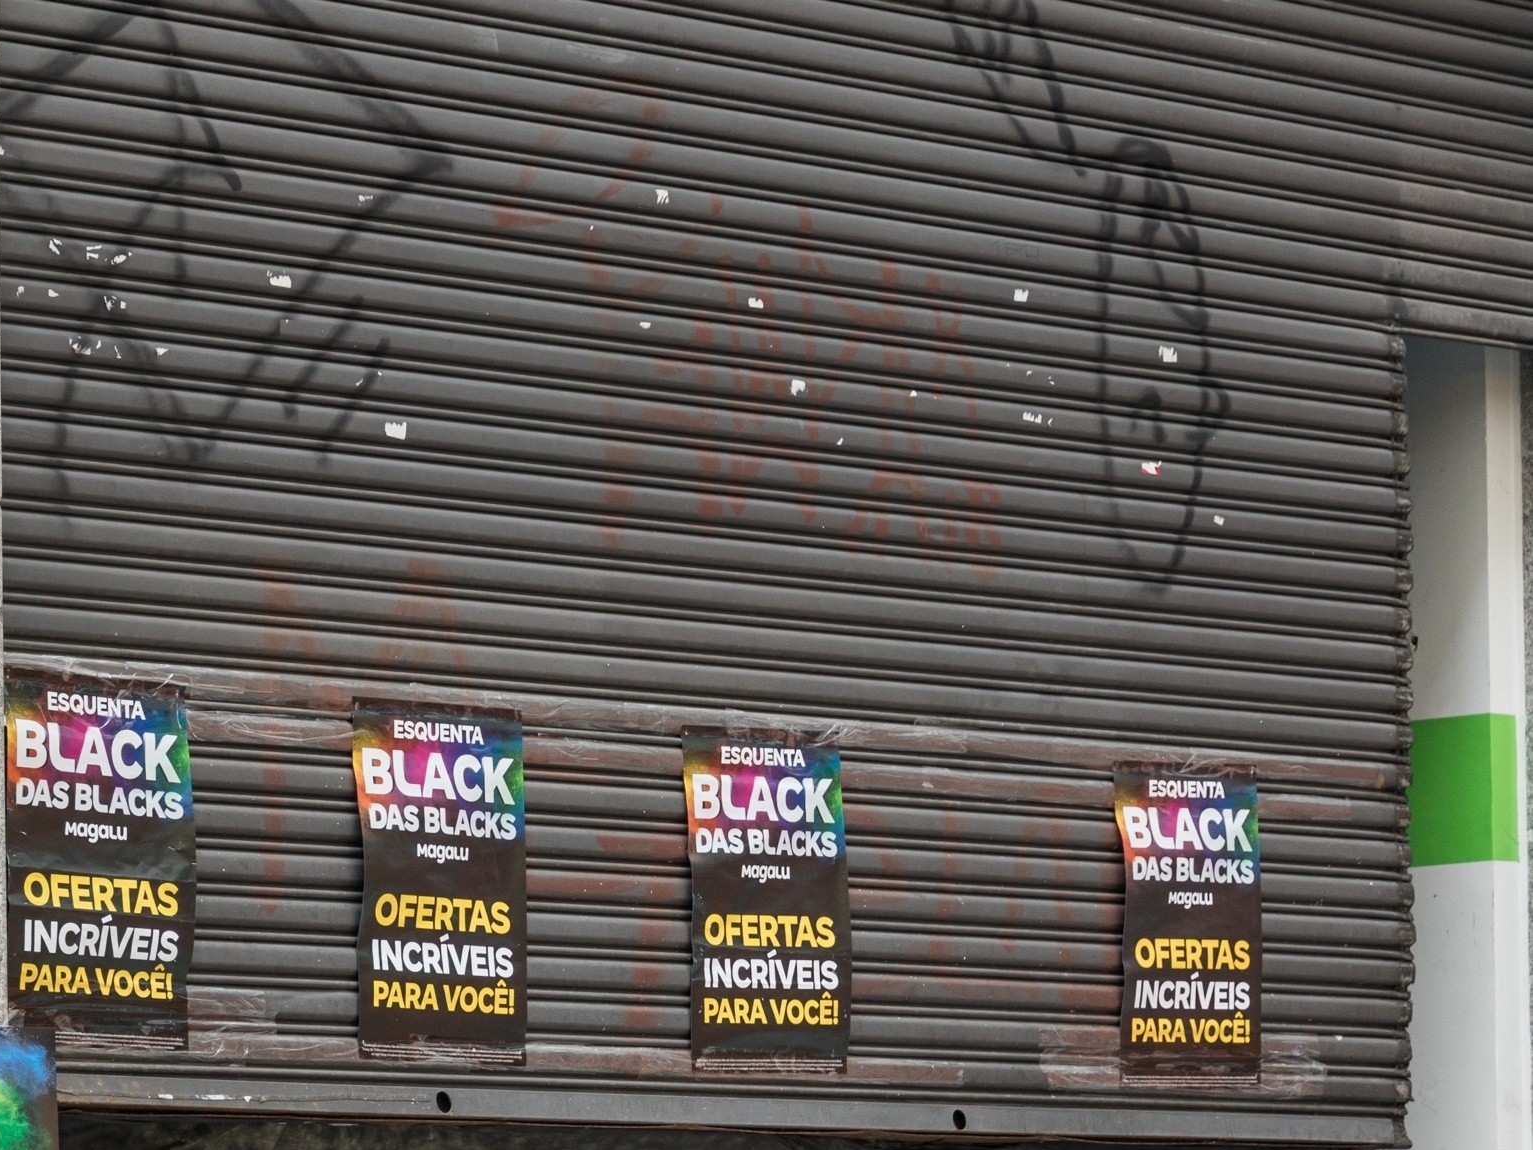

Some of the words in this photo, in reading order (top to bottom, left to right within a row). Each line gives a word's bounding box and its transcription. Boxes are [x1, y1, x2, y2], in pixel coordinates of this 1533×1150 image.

[47, 691, 146, 720] ESQUENTA
[393, 720, 484, 745] ESQUENTA
[15, 720, 179, 784] BLACK
[720, 746, 805, 767] ESQUENTA
[362, 748, 515, 805] BLACK
[1149, 780, 1225, 799] ESQUENTA
[16, 782, 69, 809] DAS
[75, 785, 184, 820] BLACKS
[693, 774, 834, 823] BLACK
[368, 808, 419, 832] DAS
[424, 809, 517, 841] BLACKS
[1123, 806, 1251, 853] BLACK
[696, 829, 744, 854] DAS
[748, 831, 837, 858] BLACKS
[1133, 856, 1173, 881] DAS
[1177, 858, 1254, 884] BLACKS
[23, 874, 178, 917] OFERTAS
[375, 894, 510, 935] OFERTAS
[704, 915, 835, 948] OFERTAS
[23, 917, 178, 962] INCRÍVEIS
[372, 935, 513, 978] INCRÍVEIS
[1134, 939, 1250, 970] OFERTAS
[19, 964, 90, 994] PARA
[95, 966, 173, 1000] VOCÊ!
[703, 951, 839, 990] INCRÍVEIS
[373, 980, 441, 1010] PARA
[446, 981, 515, 1016] VOCÊ!
[703, 998, 767, 1024] PARA
[771, 993, 839, 1025] VOCÊ!
[1134, 973, 1250, 1011] INCRÍVEIS
[1131, 1018, 1187, 1043] PARA
[1190, 1012, 1250, 1045] VOCÊ!
